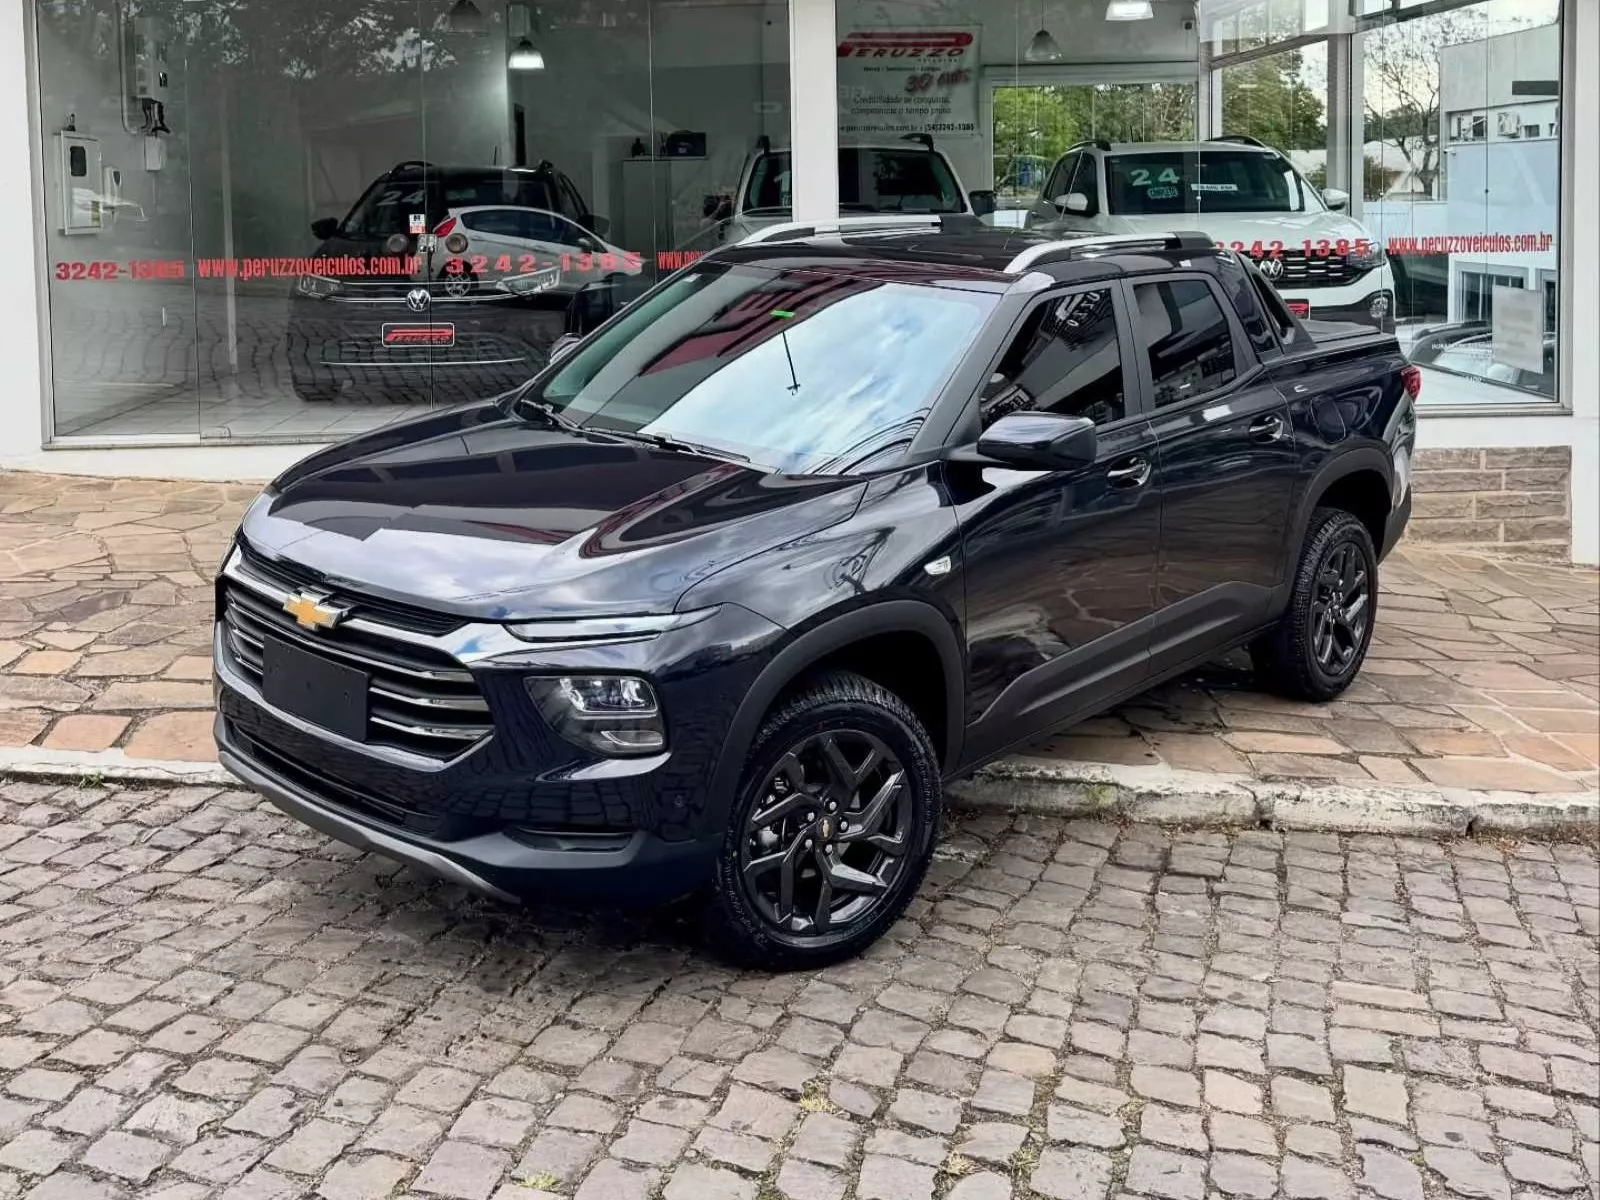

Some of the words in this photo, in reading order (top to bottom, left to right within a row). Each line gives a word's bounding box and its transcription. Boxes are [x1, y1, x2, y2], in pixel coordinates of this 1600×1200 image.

[1129, 167, 1181, 187] 24
[376, 189, 426, 207] 24
[1388, 231, 1553, 257] www.peruzzoveiculos.com.br
[197, 253, 423, 280] www.peruzzoveiculos.com.br
